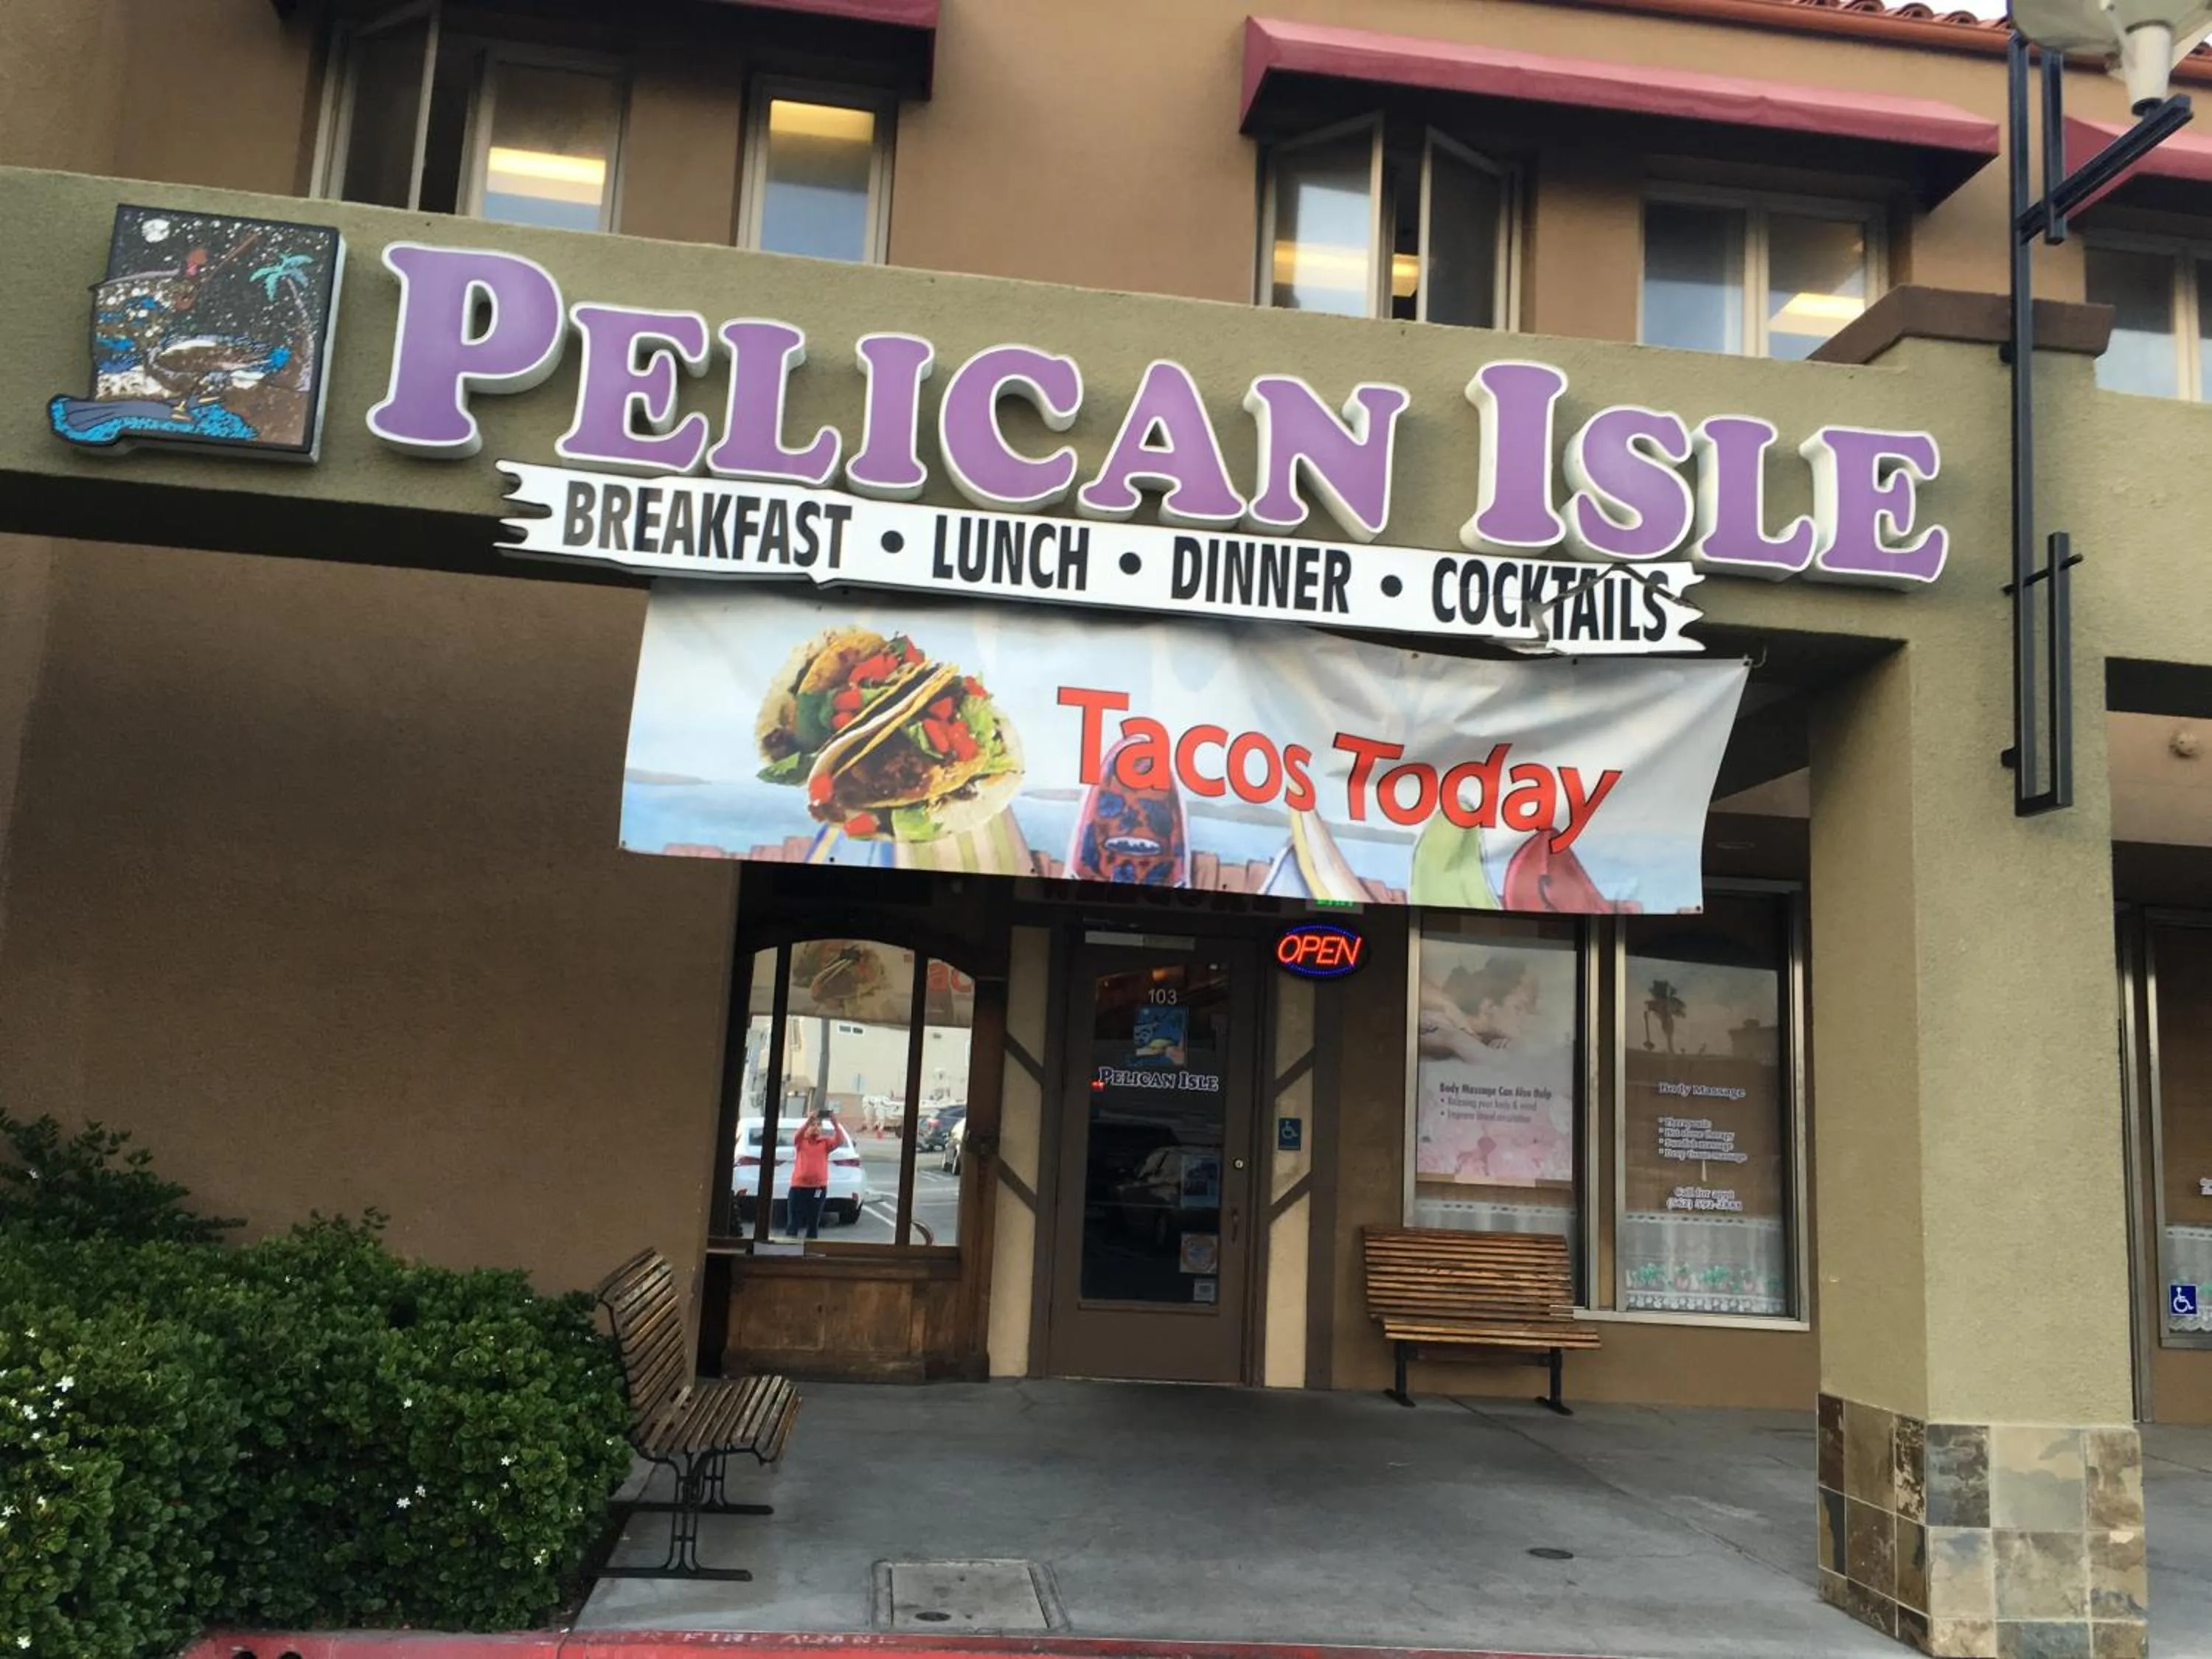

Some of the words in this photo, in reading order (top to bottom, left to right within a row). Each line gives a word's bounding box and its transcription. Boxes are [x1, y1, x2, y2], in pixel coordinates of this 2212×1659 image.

[366, 242, 1409, 539] PELICAN
[1464, 360, 1949, 584] ISLE
[563, 480, 852, 568] BREAKFAST
[932, 514, 1090, 591] LUNCH
[1171, 535, 1352, 614] DINNER
[1431, 556, 1669, 642] COCKTAILS
[1057, 686, 1315, 812] Tacos
[1332, 732, 1622, 855] Today
[1278, 934, 1362, 967] OPEN
[1149, 988, 1178, 1004] 103
[1099, 1066, 1178, 1088] PELICAN
[1178, 1071, 1219, 1091] ISLE
[1658, 1082, 1691, 1097] Body
[1692, 1085, 1746, 1100] Massage
